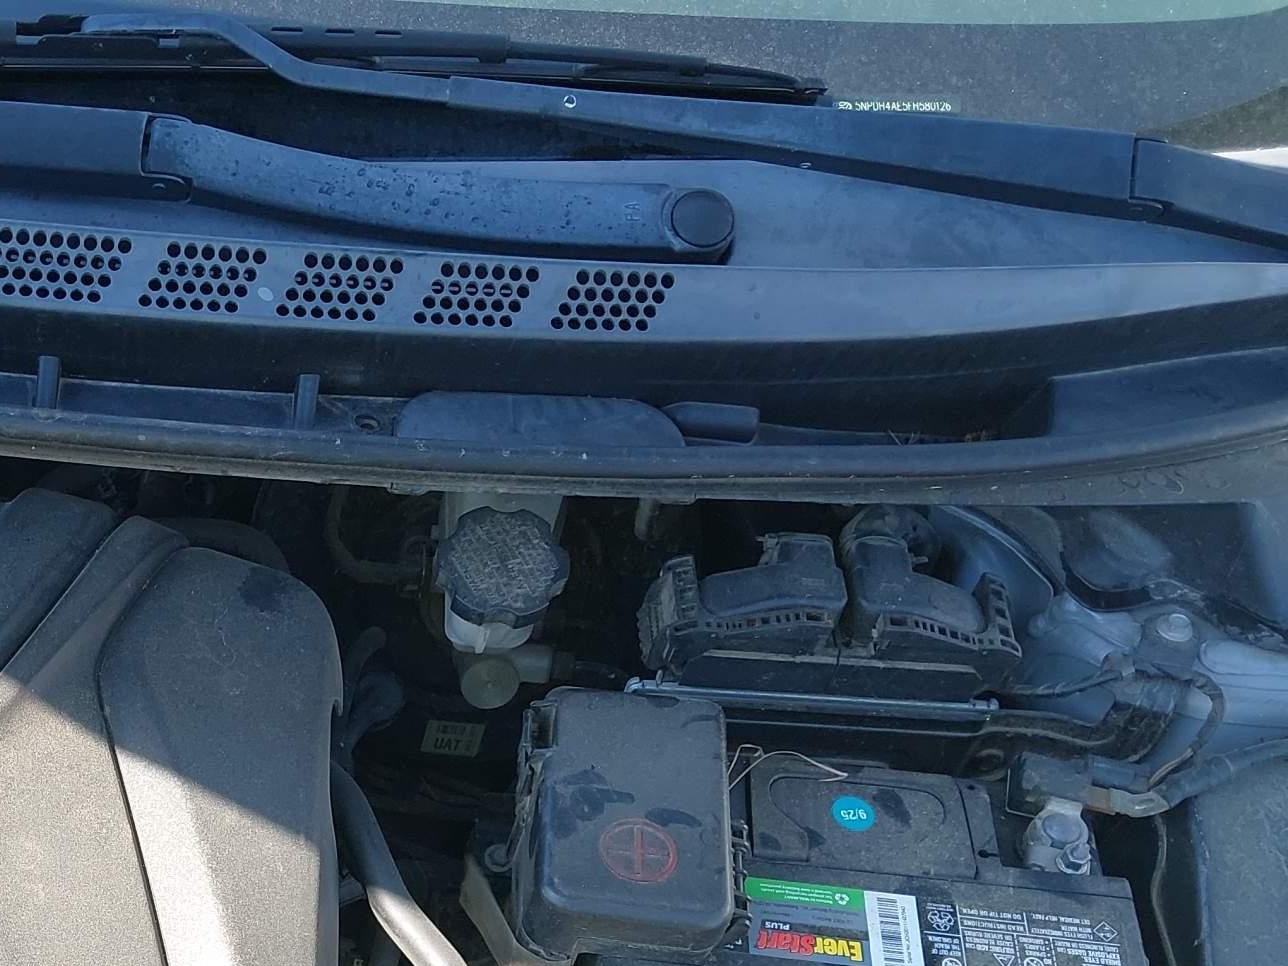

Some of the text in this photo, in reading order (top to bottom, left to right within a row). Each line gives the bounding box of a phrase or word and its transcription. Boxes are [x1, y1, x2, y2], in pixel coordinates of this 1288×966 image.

[840, 808, 867, 820] 9/25
[764, 921, 790, 931] PLUS
[756, 930, 864, 962] EverStart
